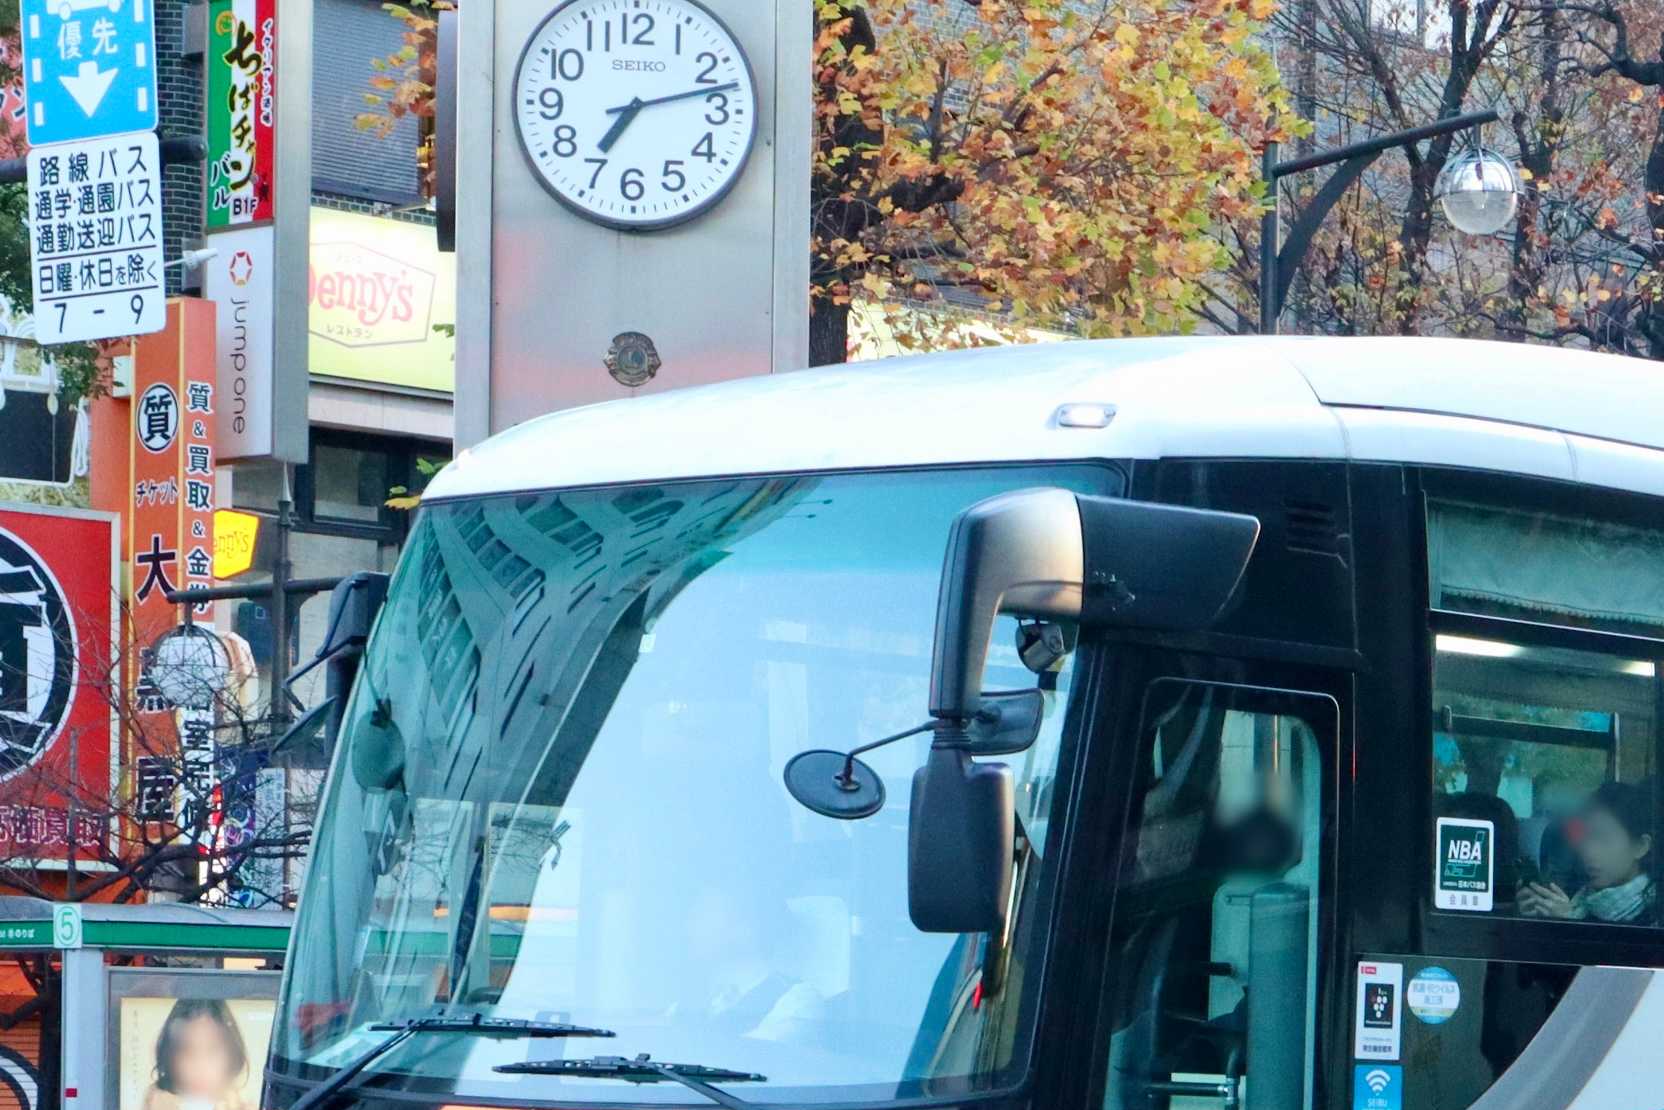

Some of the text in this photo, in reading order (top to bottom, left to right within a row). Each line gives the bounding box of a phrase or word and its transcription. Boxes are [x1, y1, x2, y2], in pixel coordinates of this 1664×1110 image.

[57, 18, 119, 60] 優先
[587, 19, 610, 52] 11
[622, 12, 655, 46] 12
[551, 48, 584, 82] 10
[611, 59, 666, 73] SEIKO
[694, 52, 719, 84] 2
[539, 87, 564, 121] 9
[704, 92, 730, 126] 3
[552, 125, 578, 158] 8
[691, 132, 717, 164] 4
[39, 146, 148, 186] 路線バス
[584, 158, 609, 190] 7
[661, 160, 686, 192] 5
[620, 168, 645, 201] 6
[232, 197, 257, 216] B1F
[36, 212, 156, 255] 通勤送迎バス
[326, 324, 373, 340] レストラン
[144, 393, 173, 443] 質
[136, 479, 178, 506] チケット
[213, 527, 250, 561] enny's
[1447, 839, 1482, 862] NBA
